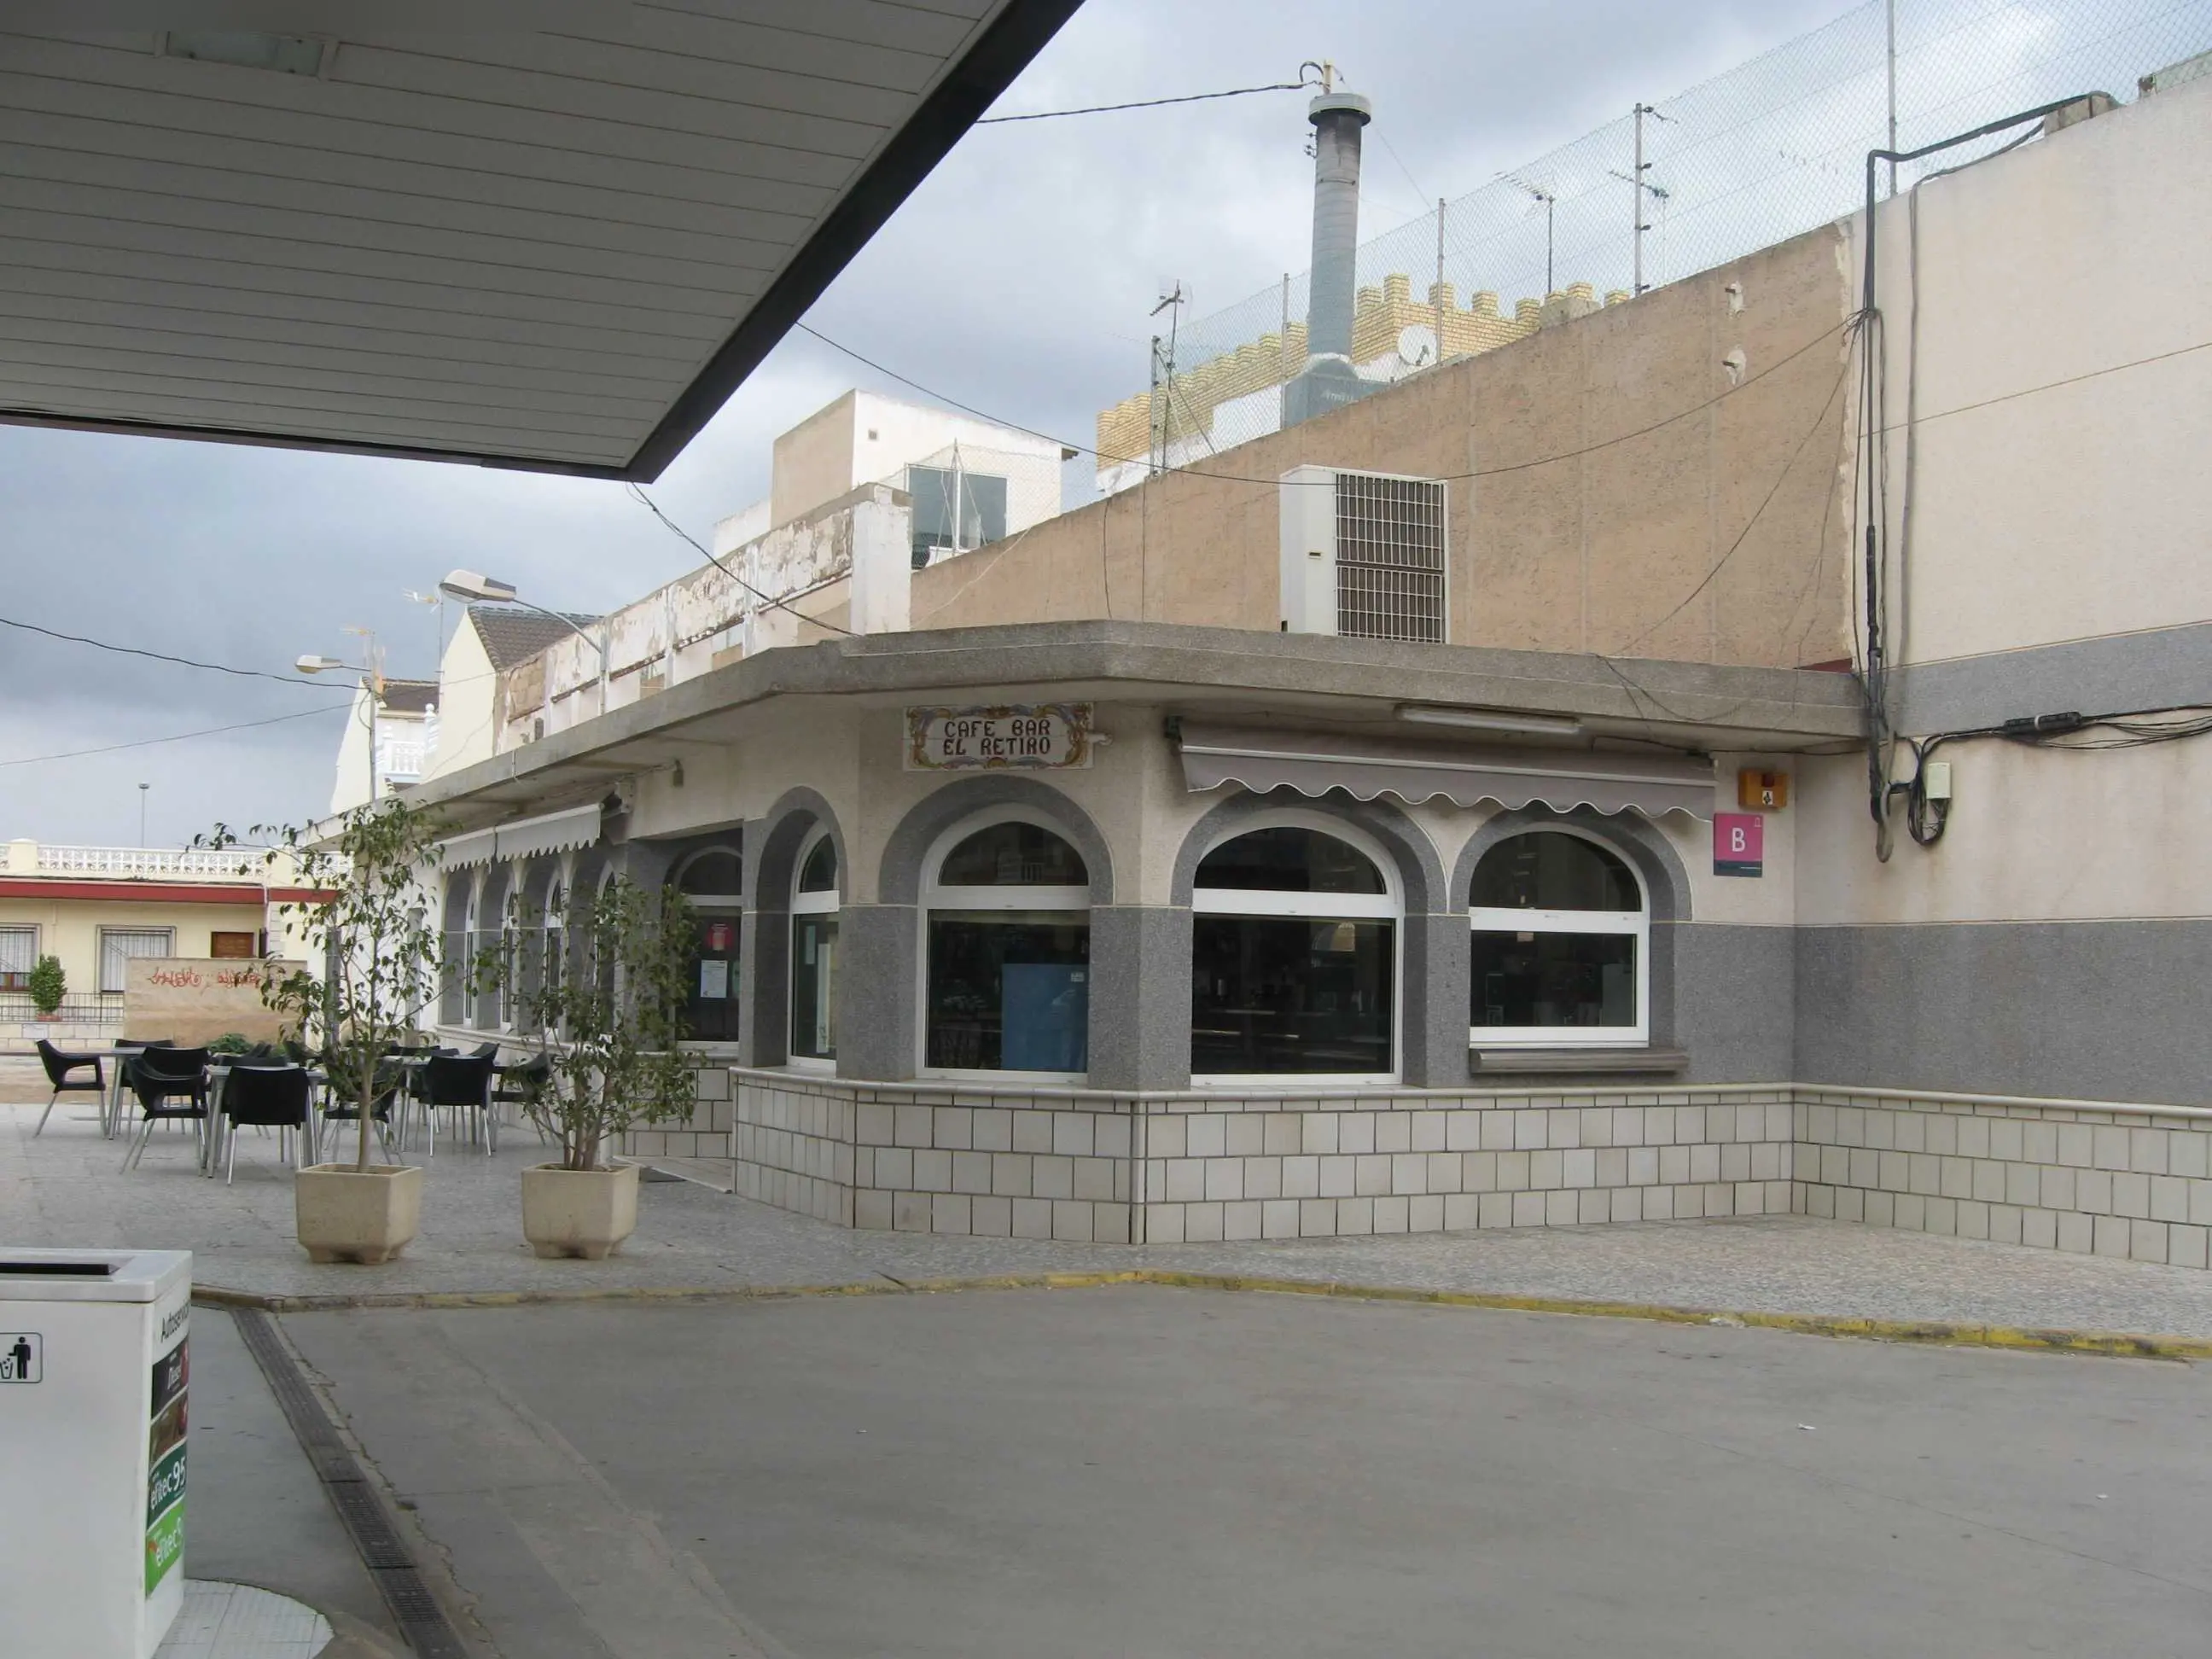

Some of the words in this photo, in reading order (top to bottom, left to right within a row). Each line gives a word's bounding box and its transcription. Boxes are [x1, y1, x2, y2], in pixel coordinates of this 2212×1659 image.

[944, 720, 996, 738] CAFE
[1011, 719, 1051, 736] BAR
[943, 737, 967, 756] EL
[981, 736, 1051, 755] RETIRO
[1732, 827, 1745, 852] B
